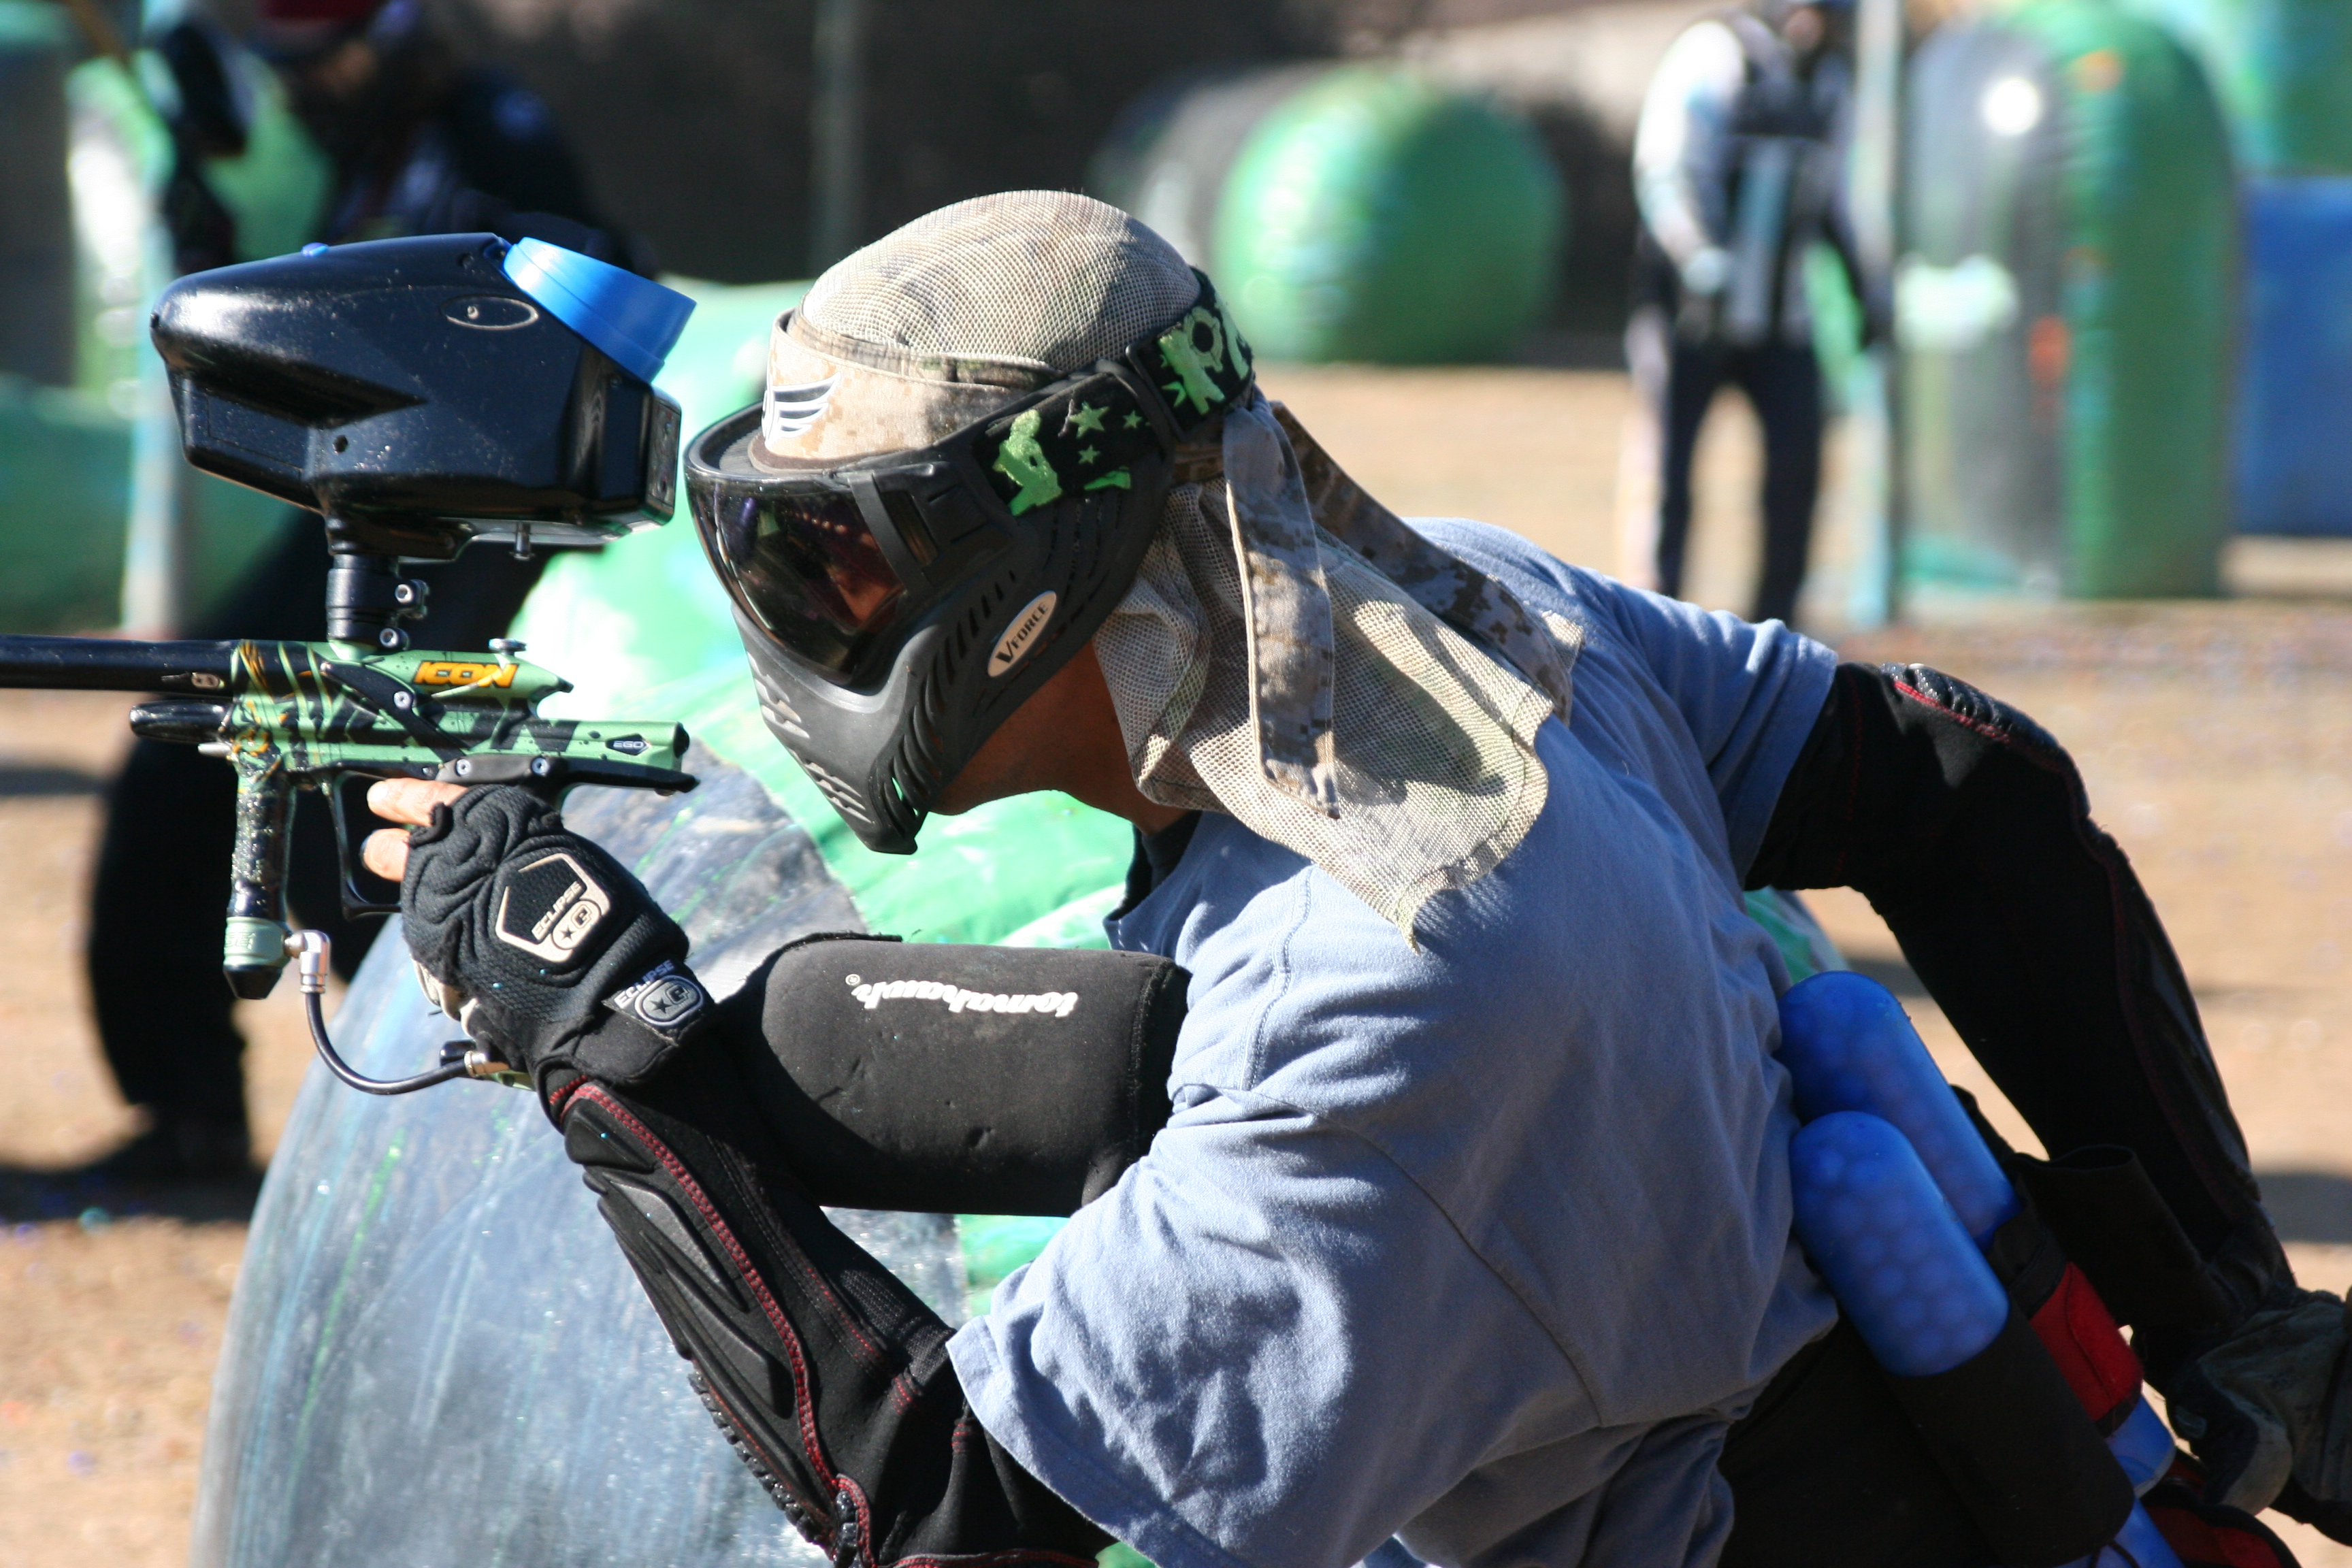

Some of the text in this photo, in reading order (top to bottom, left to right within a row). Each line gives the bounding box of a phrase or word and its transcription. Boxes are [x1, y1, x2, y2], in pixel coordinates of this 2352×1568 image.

[414, 659, 520, 688] ICON
[612, 739, 645, 750] EGO
[532, 881, 583, 941] ECLIPSE
[614, 960, 674, 1009] ECLIPSE
